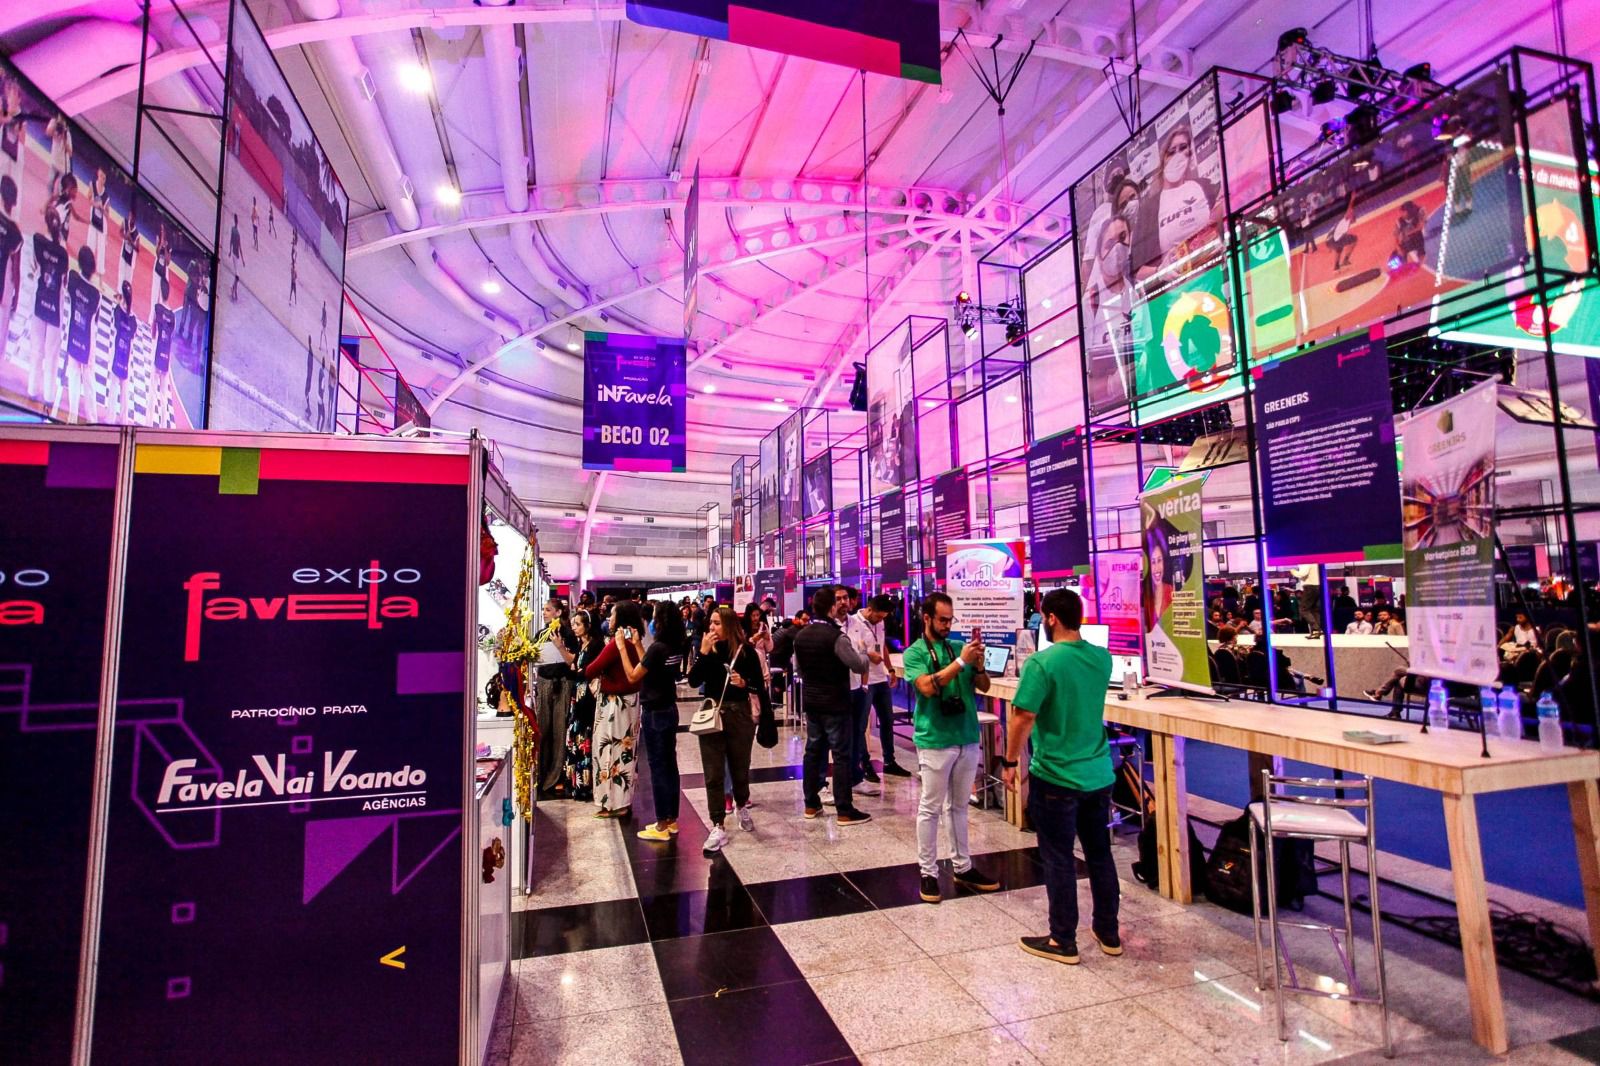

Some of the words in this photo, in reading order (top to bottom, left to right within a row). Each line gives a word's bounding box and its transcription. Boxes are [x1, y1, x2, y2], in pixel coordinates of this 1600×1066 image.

[1264, 392, 1309, 414] GREENERS
[601, 425, 643, 445] BECO
[649, 427, 670, 446] 02
[1158, 490, 1201, 519] veriza
[1111, 562, 1139, 572] ATENÇÃO
[292, 568, 421, 588] expo
[231, 705, 317, 719] PATROCÍNIO
[322, 704, 368, 715] PRATA
[157, 758, 264, 804] Favela
[252, 753, 314, 796] Vai
[322, 749, 427, 793] Voando
[362, 796, 427, 812] AGÊNCIAS
